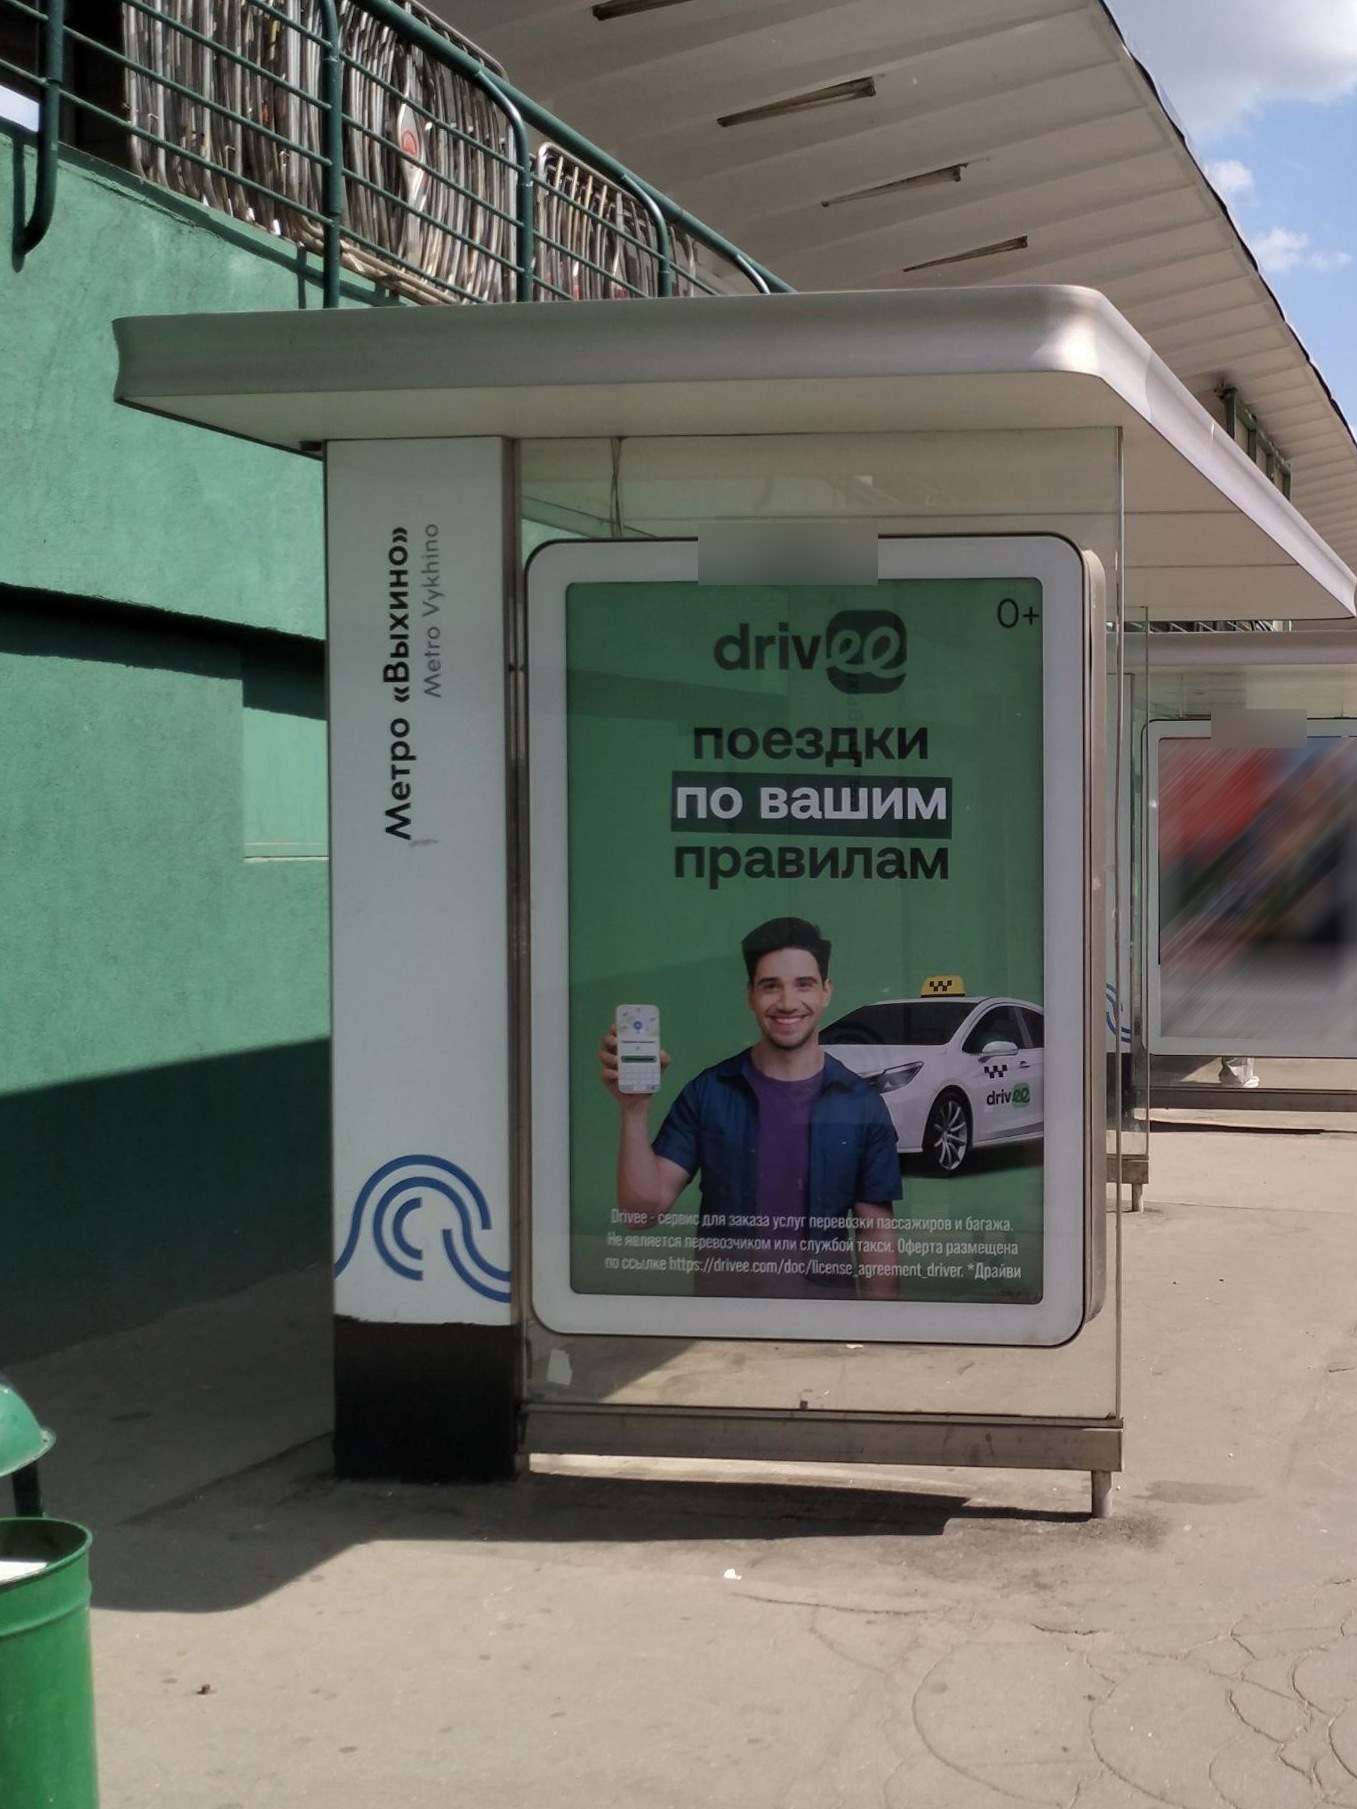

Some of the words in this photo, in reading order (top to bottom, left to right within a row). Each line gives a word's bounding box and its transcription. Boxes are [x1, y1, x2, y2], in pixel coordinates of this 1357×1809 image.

[420, 523, 445, 617] Vykhino
[382, 526, 411, 703] «Выхино»
[997, 597, 1040, 628] 0+
[423, 626, 442, 698] Metro
[714, 611, 908, 692] drivee
[693, 726, 928, 768] поездки
[384, 717, 417, 841] Метро
[676, 786, 743, 819] по
[759, 786, 947, 820] вашим
[674, 845, 949, 890] правилам
[986, 1085, 1030, 1107] drivee
[611, 1208, 647, 1224] Drivee
[658, 1214, 699, 1227] сервис
[702, 1215, 726, 1227] для
[729, 1215, 770, 1227] заказа
[772, 1215, 807, 1230] услуг
[809, 1216, 874, 1229] перевозки
[876, 1217, 951, 1231] пассажиров
[954, 1218, 963, 1230] и
[966, 1215, 1014, 1231] багажа.
[604, 1258, 620, 1269] по
[622, 1258, 667, 1271] ссылке
[607, 1231, 622, 1247] Не
[624, 1235, 682, 1248] является
[684, 1236, 771, 1251] перевозчиком
[774, 1237, 797, 1250] или
[799, 1237, 854, 1254] службой
[857, 1240, 895, 1252] такси.
[898, 1238, 944, 1256] Оферта
[946, 1242, 1019, 1257] размещена
